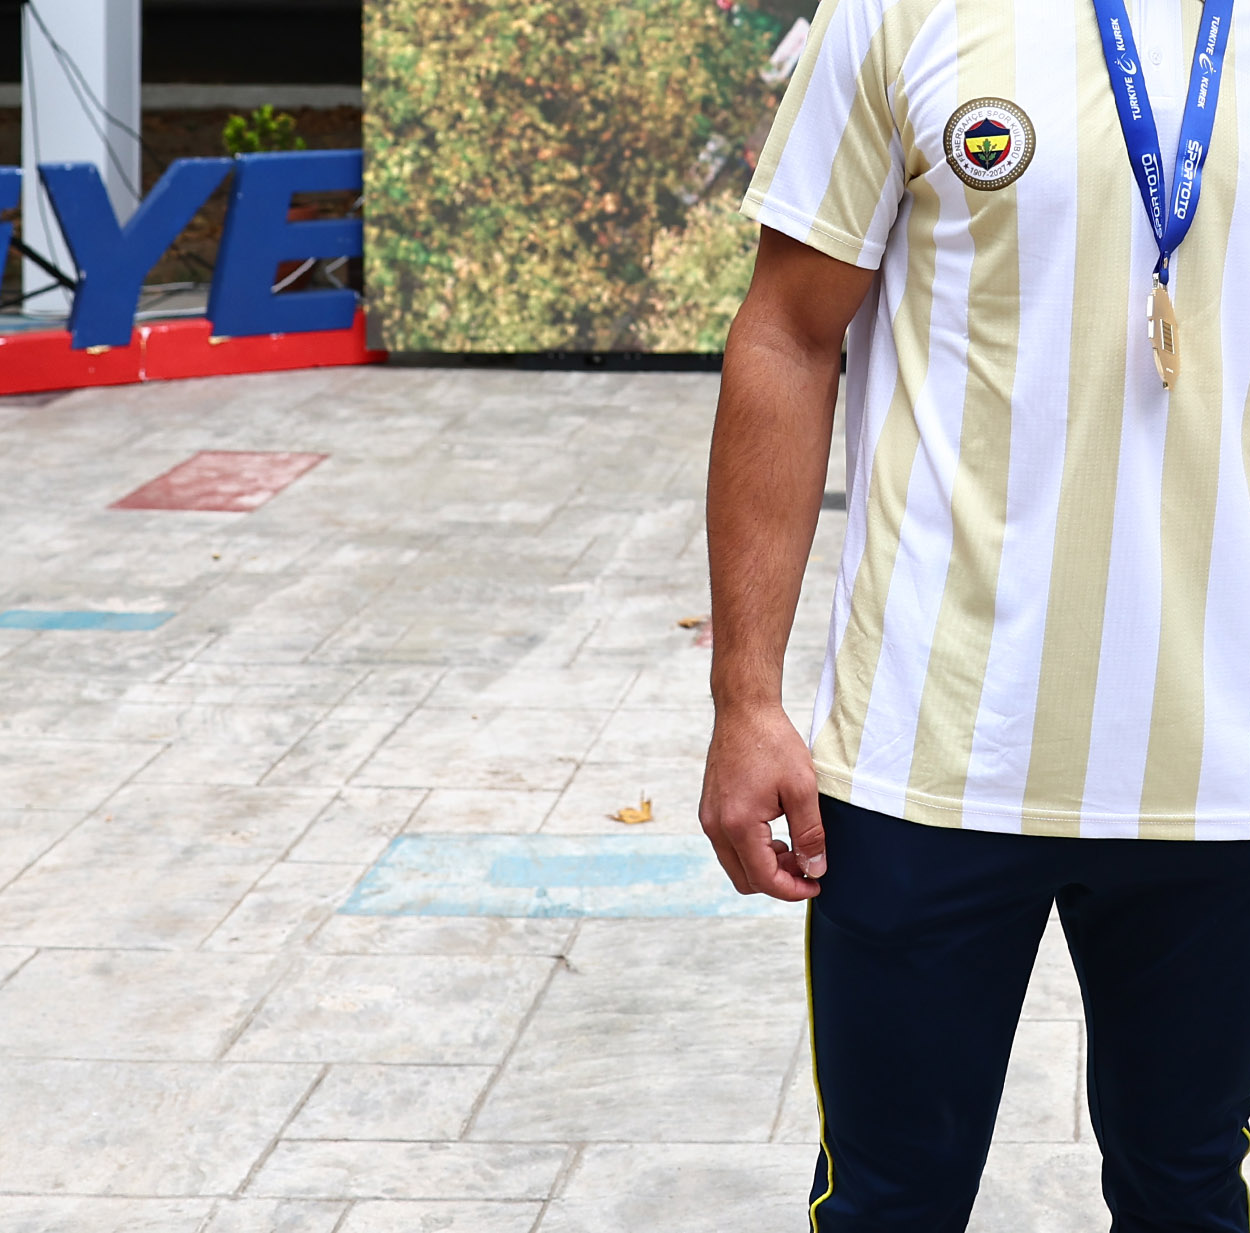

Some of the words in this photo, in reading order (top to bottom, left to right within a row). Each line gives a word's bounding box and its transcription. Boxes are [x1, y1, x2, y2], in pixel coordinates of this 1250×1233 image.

[986, 110, 1012, 124] SPOR
[970, 164, 1007, 178] 1907-2027
[1141, 153, 1163, 239] SPORTOTO
[1177, 139, 1200, 220] SPORTOTO
[0, 149, 364, 350] YE
